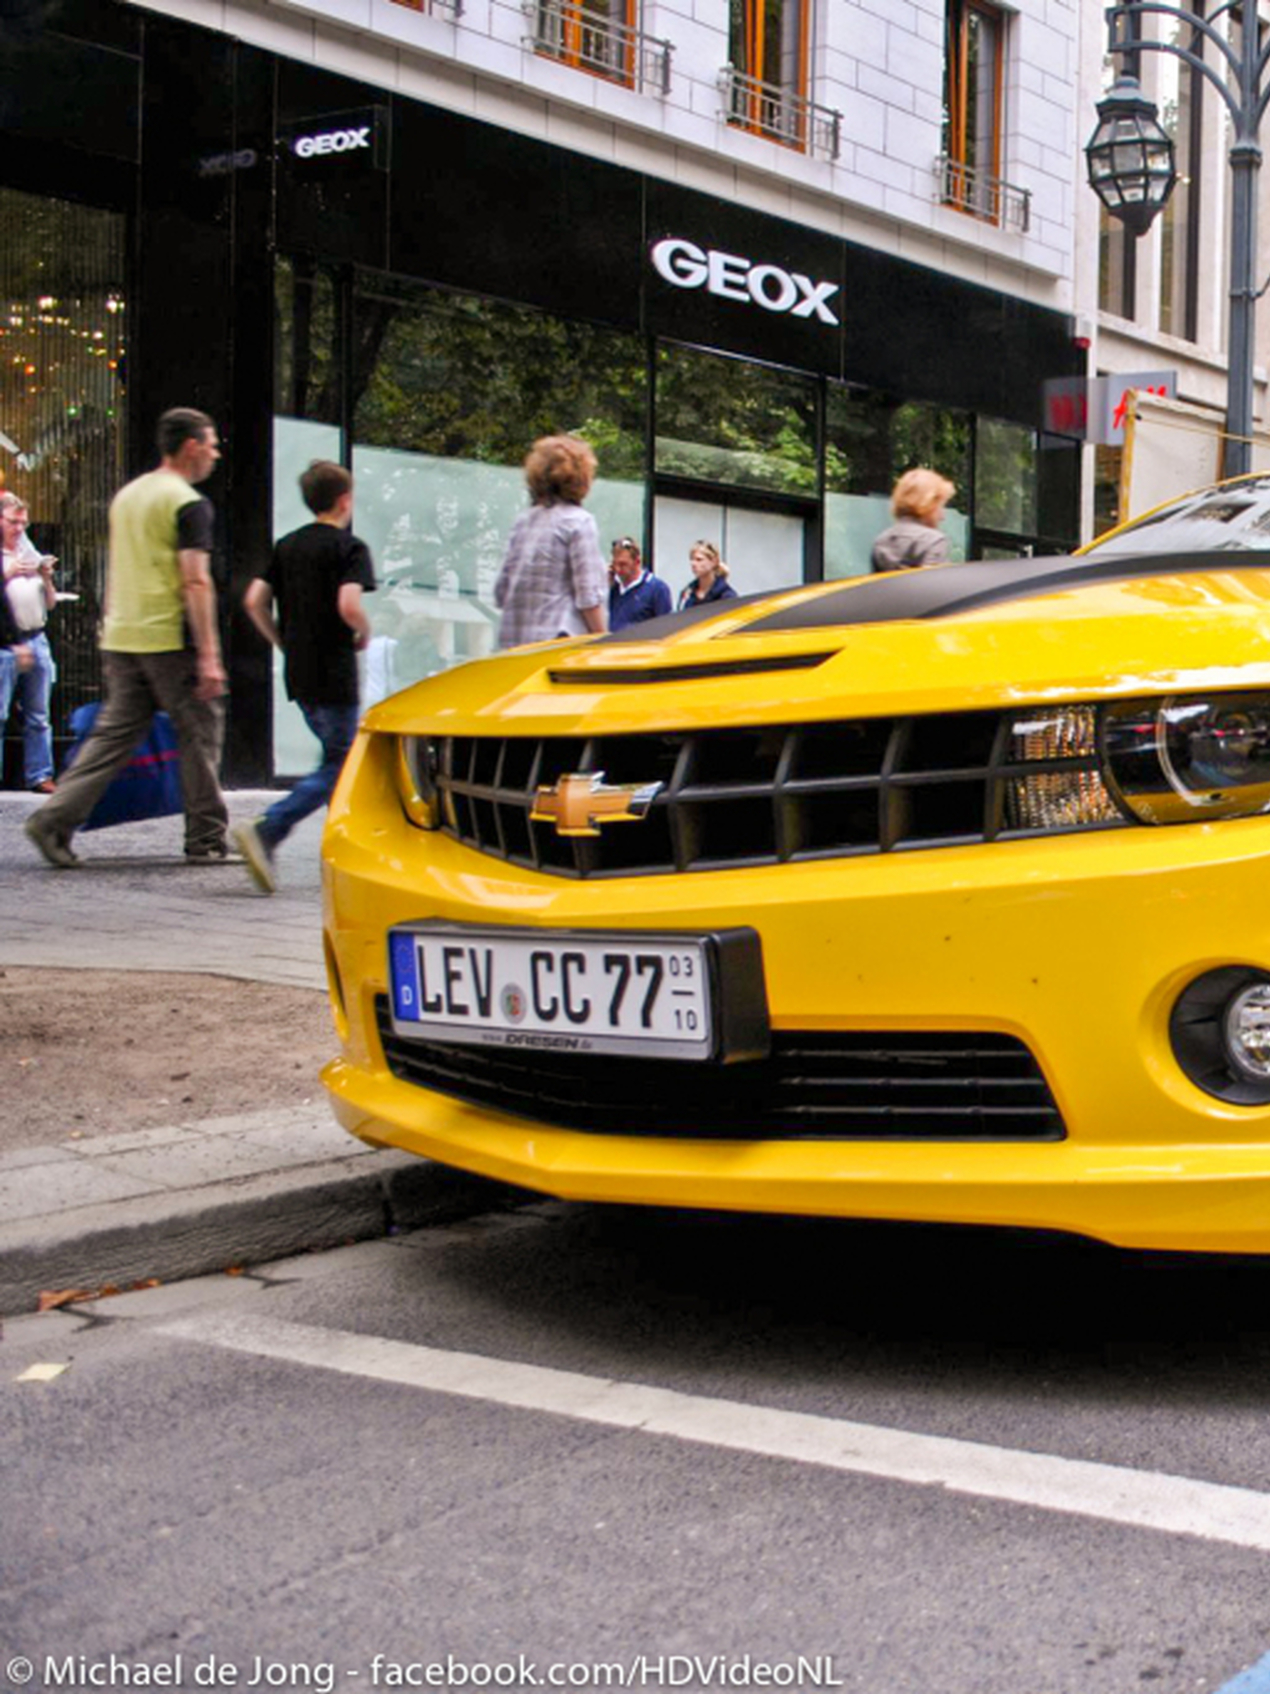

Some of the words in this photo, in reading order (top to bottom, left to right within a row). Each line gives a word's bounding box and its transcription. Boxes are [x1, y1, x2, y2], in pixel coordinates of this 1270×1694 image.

[295, 127, 371, 158] GEOX
[652, 238, 840, 326] GEOX
[669, 954, 694, 977] 03
[401, 985, 413, 1005] D
[417, 945, 493, 1018] LEV
[530, 951, 591, 1025] CC
[603, 953, 664, 1029] 77
[674, 1008, 698, 1030] 10
